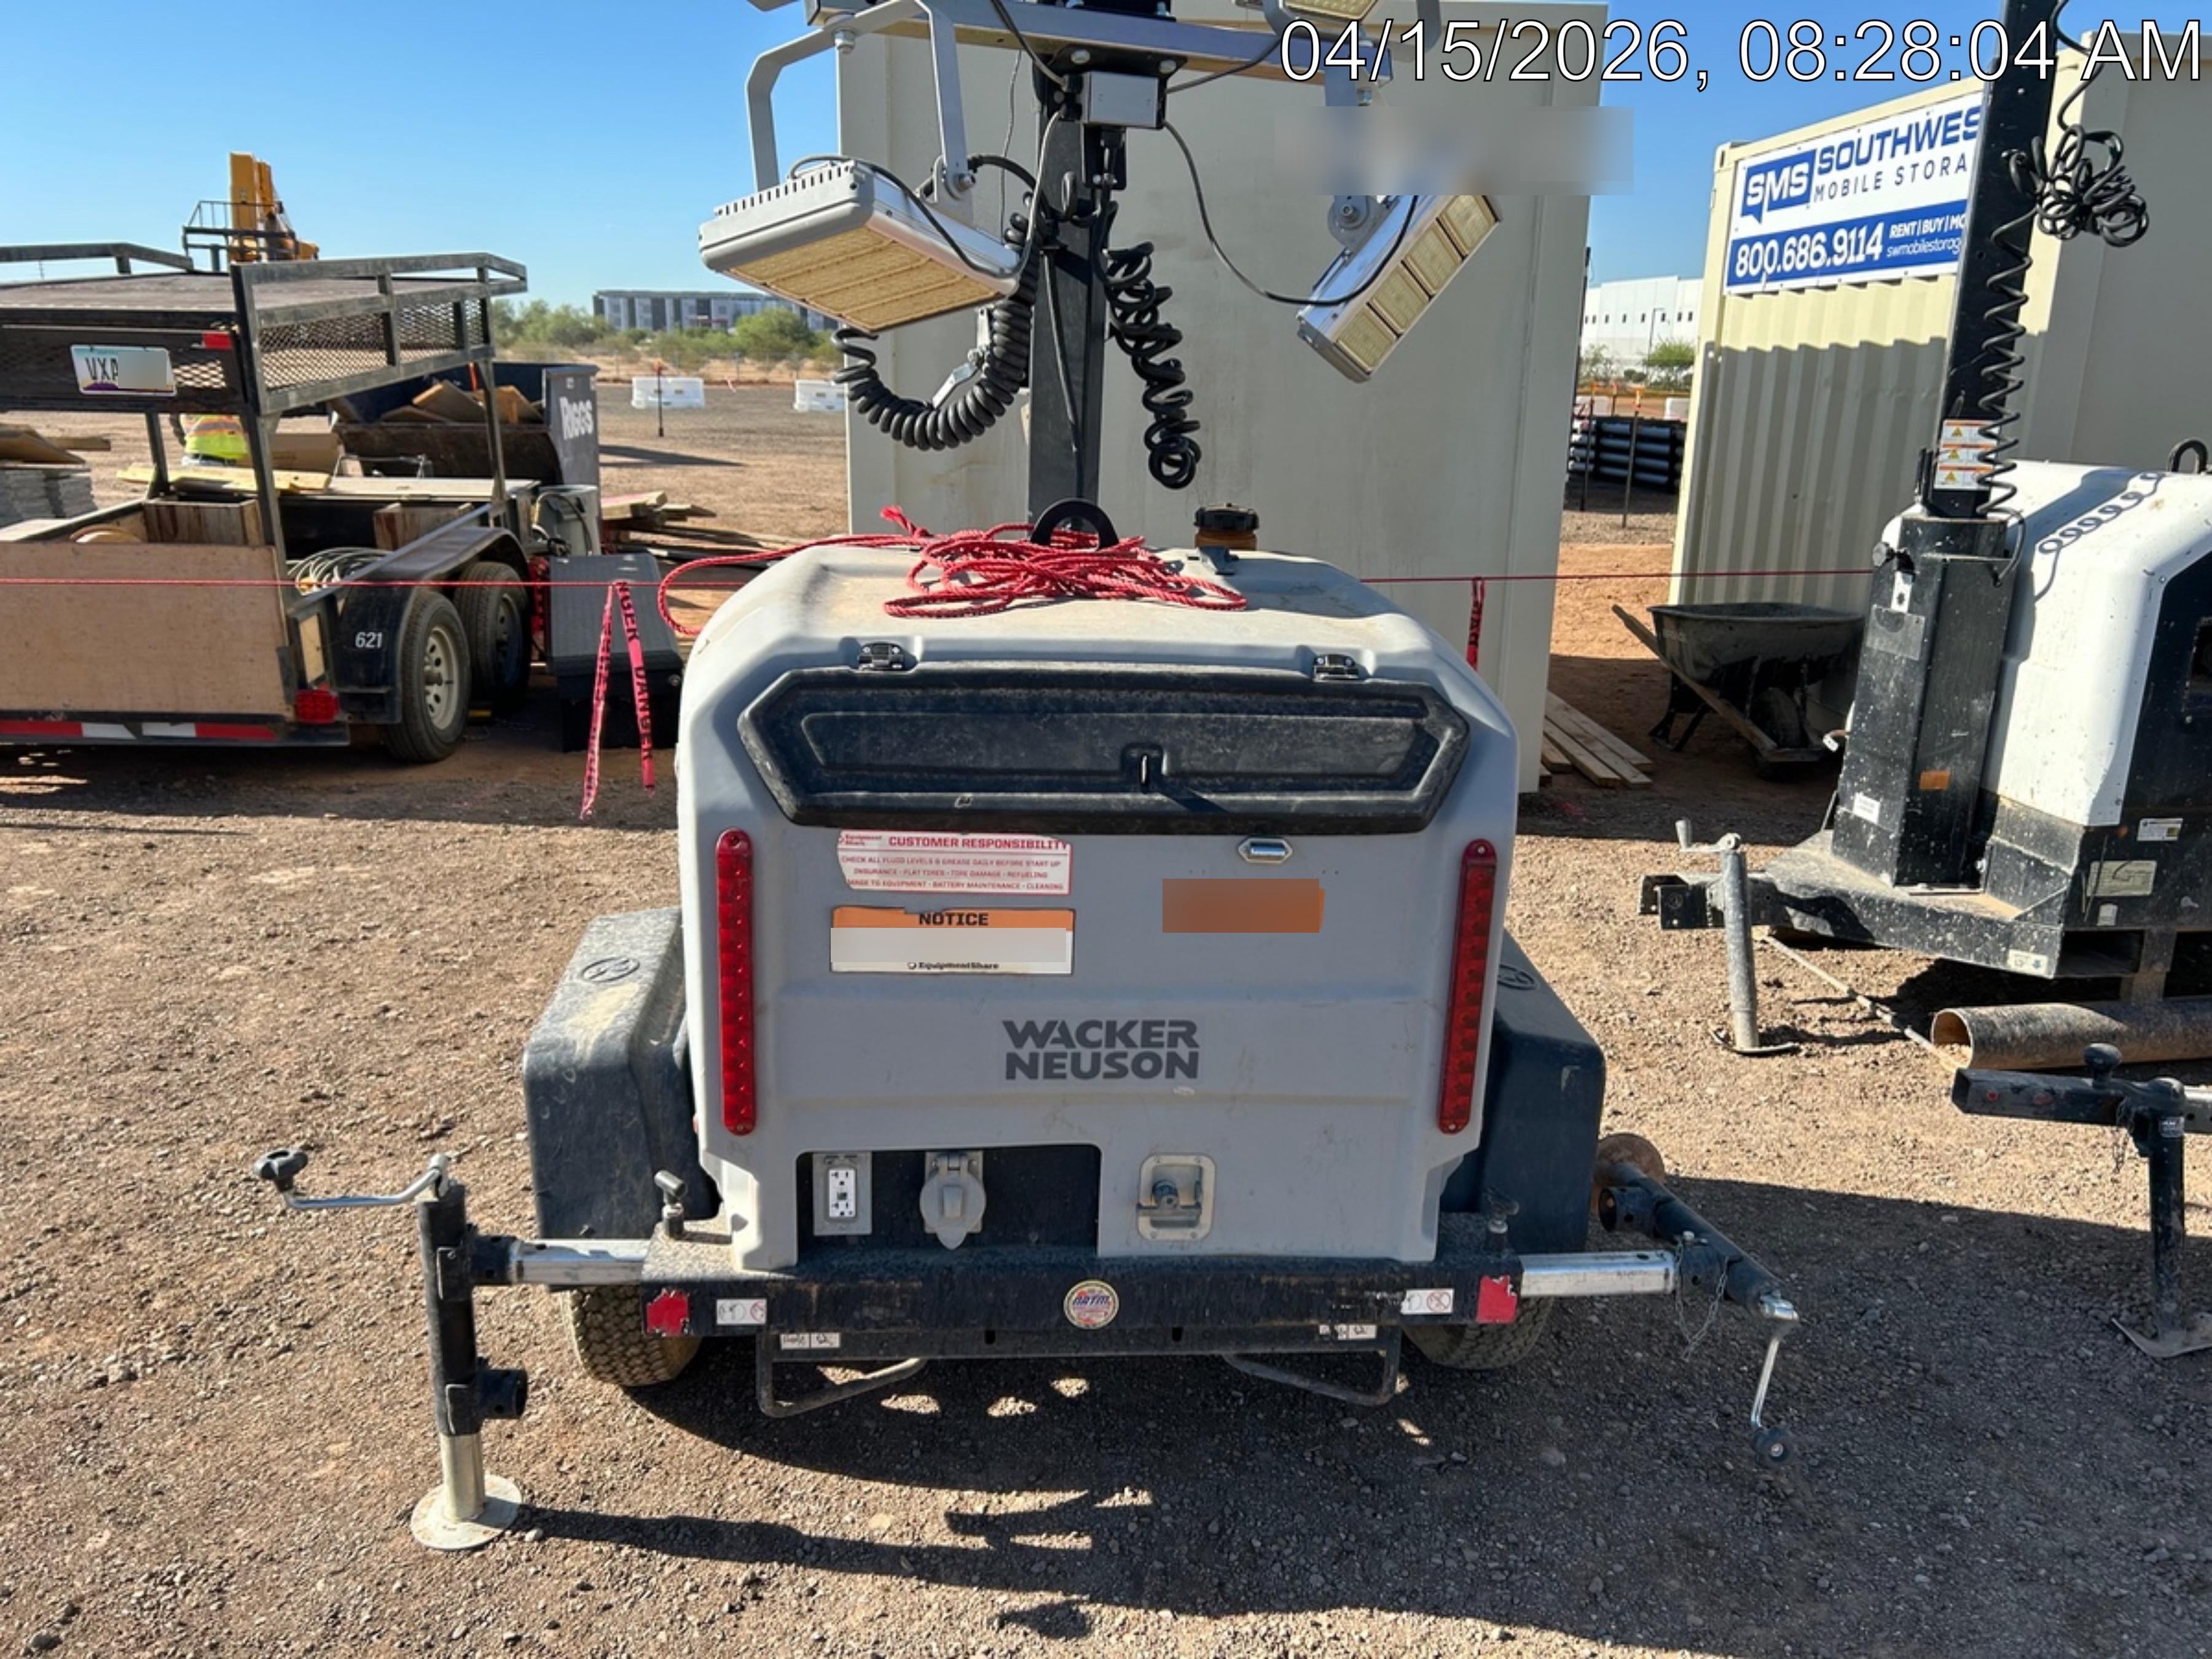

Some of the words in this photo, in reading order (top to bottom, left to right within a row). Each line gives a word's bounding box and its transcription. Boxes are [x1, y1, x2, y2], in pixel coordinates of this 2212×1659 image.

[1818, 104, 1981, 176] SOUTHWES
[1745, 161, 1809, 206] SMS
[1813, 170, 1883, 203] MOBILE
[1894, 152, 1967, 187] STORA
[1735, 221, 1885, 278] 800.686.9114
[355, 631, 383, 649] 621
[634, 667, 653, 761] DANGER
[888, 836, 959, 847] CUSTOMER
[962, 838, 1067, 850] RESPONSIBILITY
[919, 912, 989, 926] NOTICE
[1002, 1019, 1200, 1049] WACKER
[1006, 1051, 1199, 1080] NEUSON
